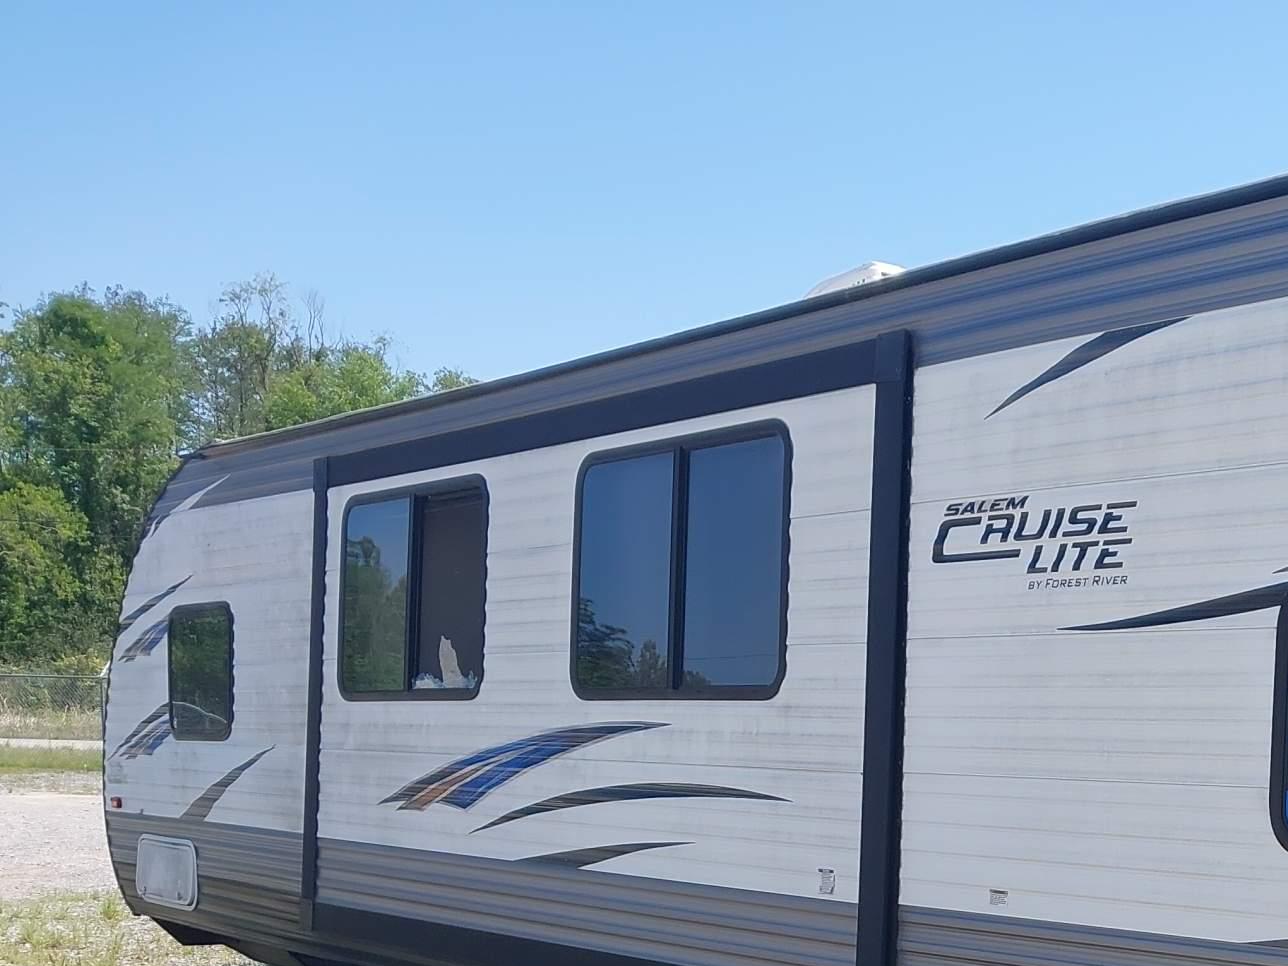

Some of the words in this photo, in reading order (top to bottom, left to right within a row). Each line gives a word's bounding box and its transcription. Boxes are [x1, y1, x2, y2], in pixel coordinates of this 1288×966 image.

[943, 495, 1030, 517] SALEM
[932, 501, 1138, 564] CRUISE
[1026, 538, 1133, 574] LITE
[1028, 579, 1042, 590] BY
[1045, 577, 1090, 589] FOREST
[1092, 575, 1128, 586] RIVER
